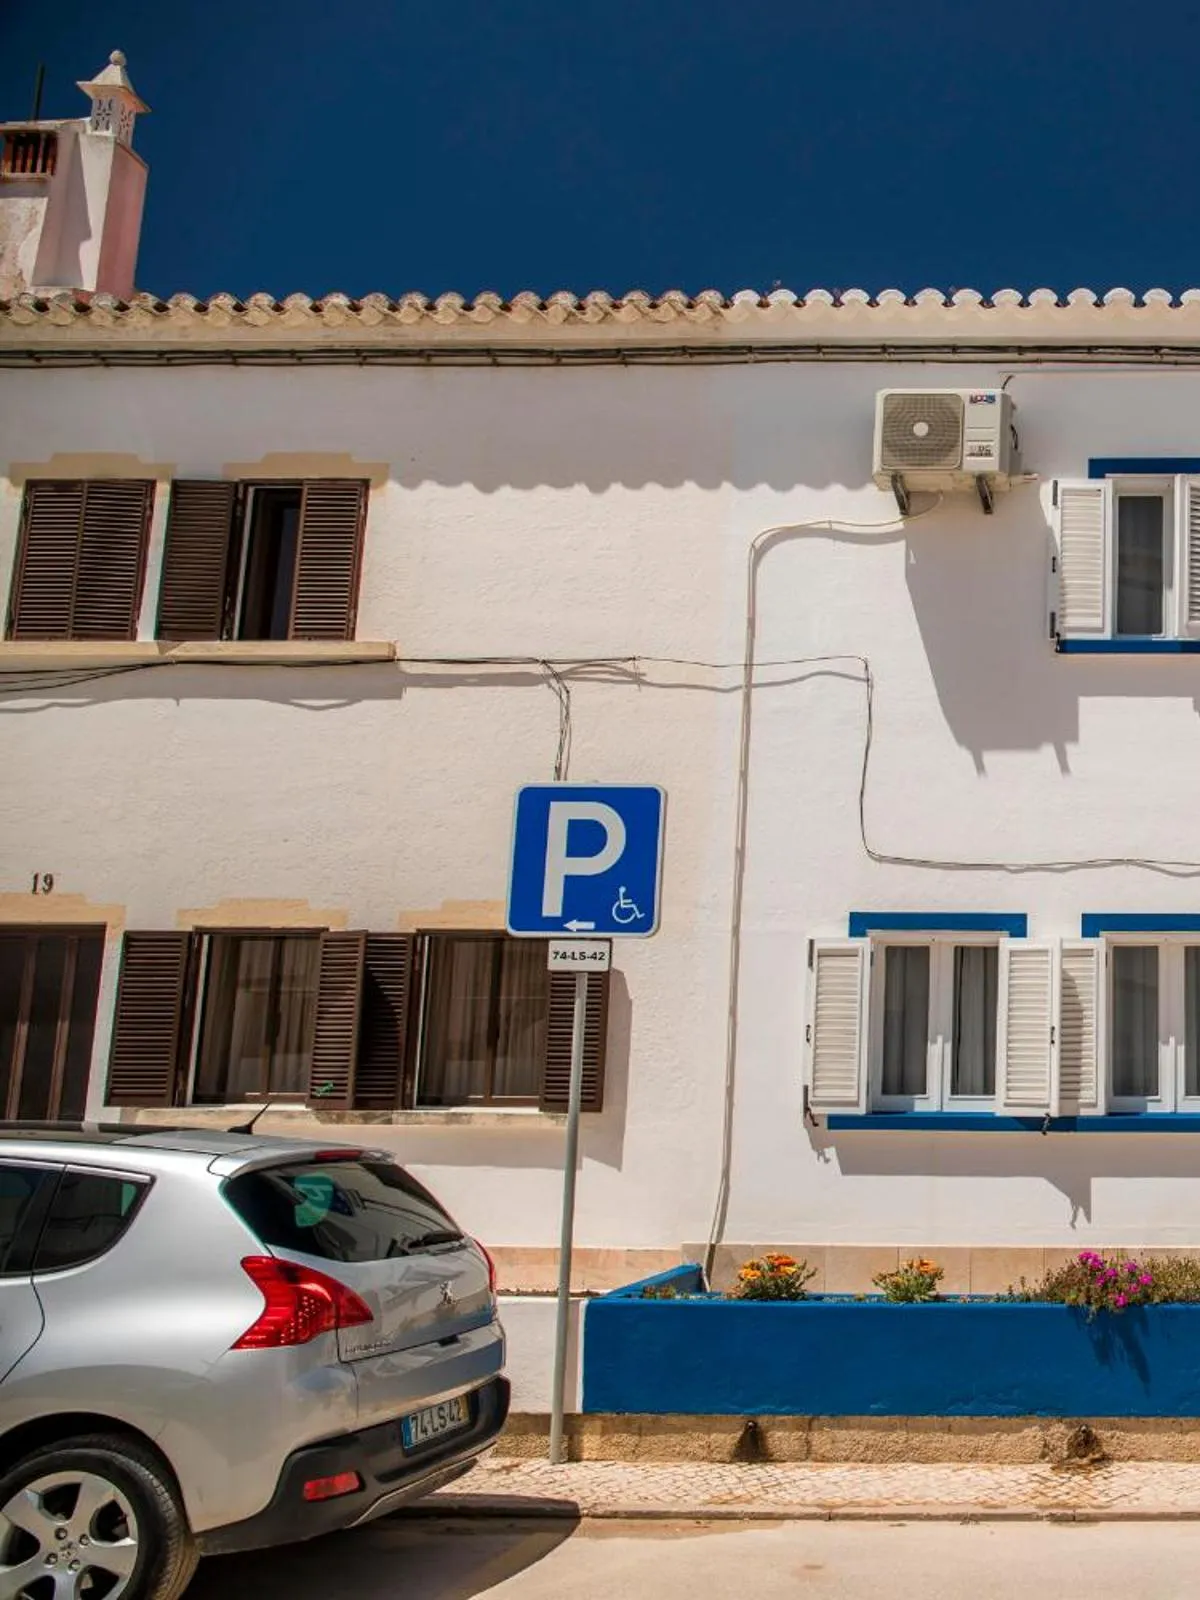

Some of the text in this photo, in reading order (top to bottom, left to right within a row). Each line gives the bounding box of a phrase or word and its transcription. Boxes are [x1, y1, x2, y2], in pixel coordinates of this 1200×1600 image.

[542, 801, 626, 917] P
[32, 872, 53, 895] 19
[553, 950, 606, 961] 74-LS-42
